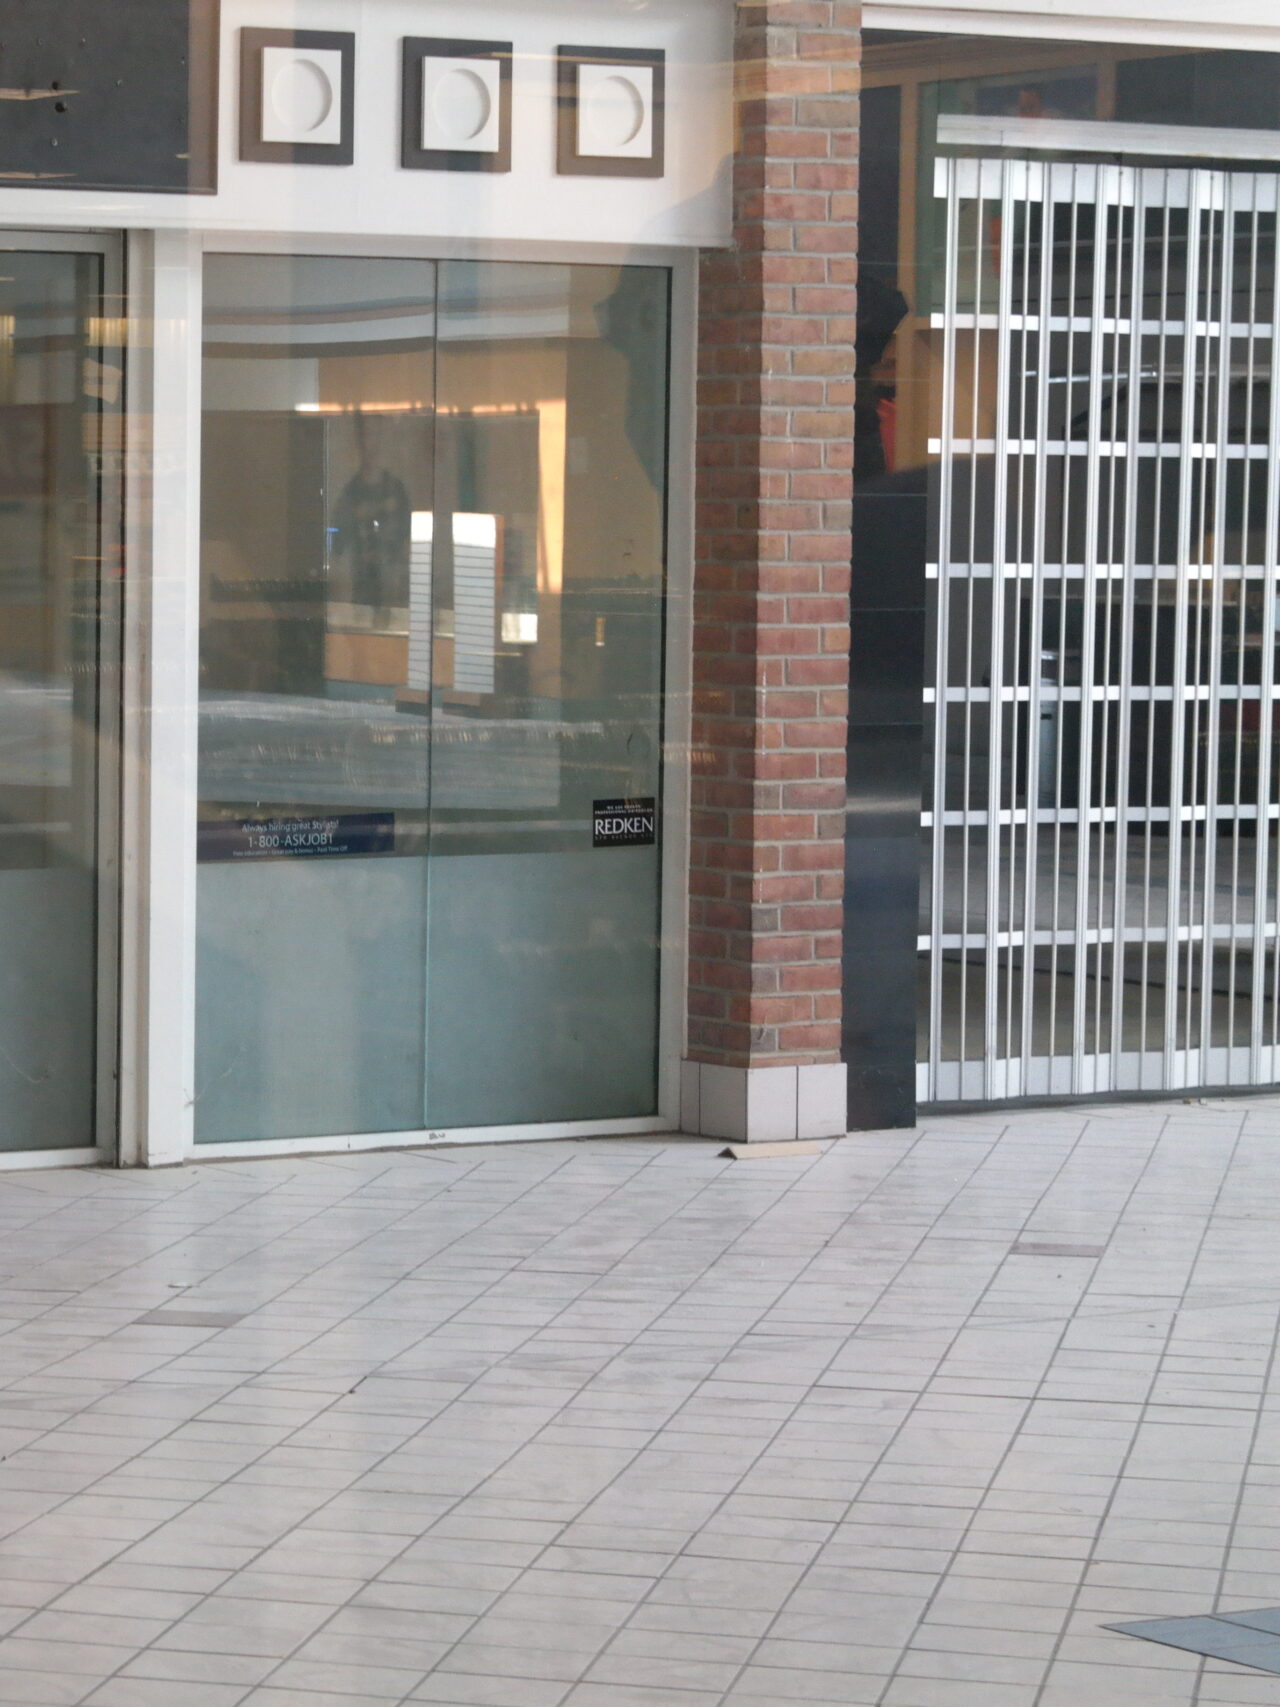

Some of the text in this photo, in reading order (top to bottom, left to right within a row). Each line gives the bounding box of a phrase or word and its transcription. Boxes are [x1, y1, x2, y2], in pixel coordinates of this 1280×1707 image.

[241, 823, 268, 833] Always
[269, 822, 290, 832] hiring
[595, 816, 653, 835] REDKEN
[248, 832, 334, 848] 1-800-ASKJOB1
